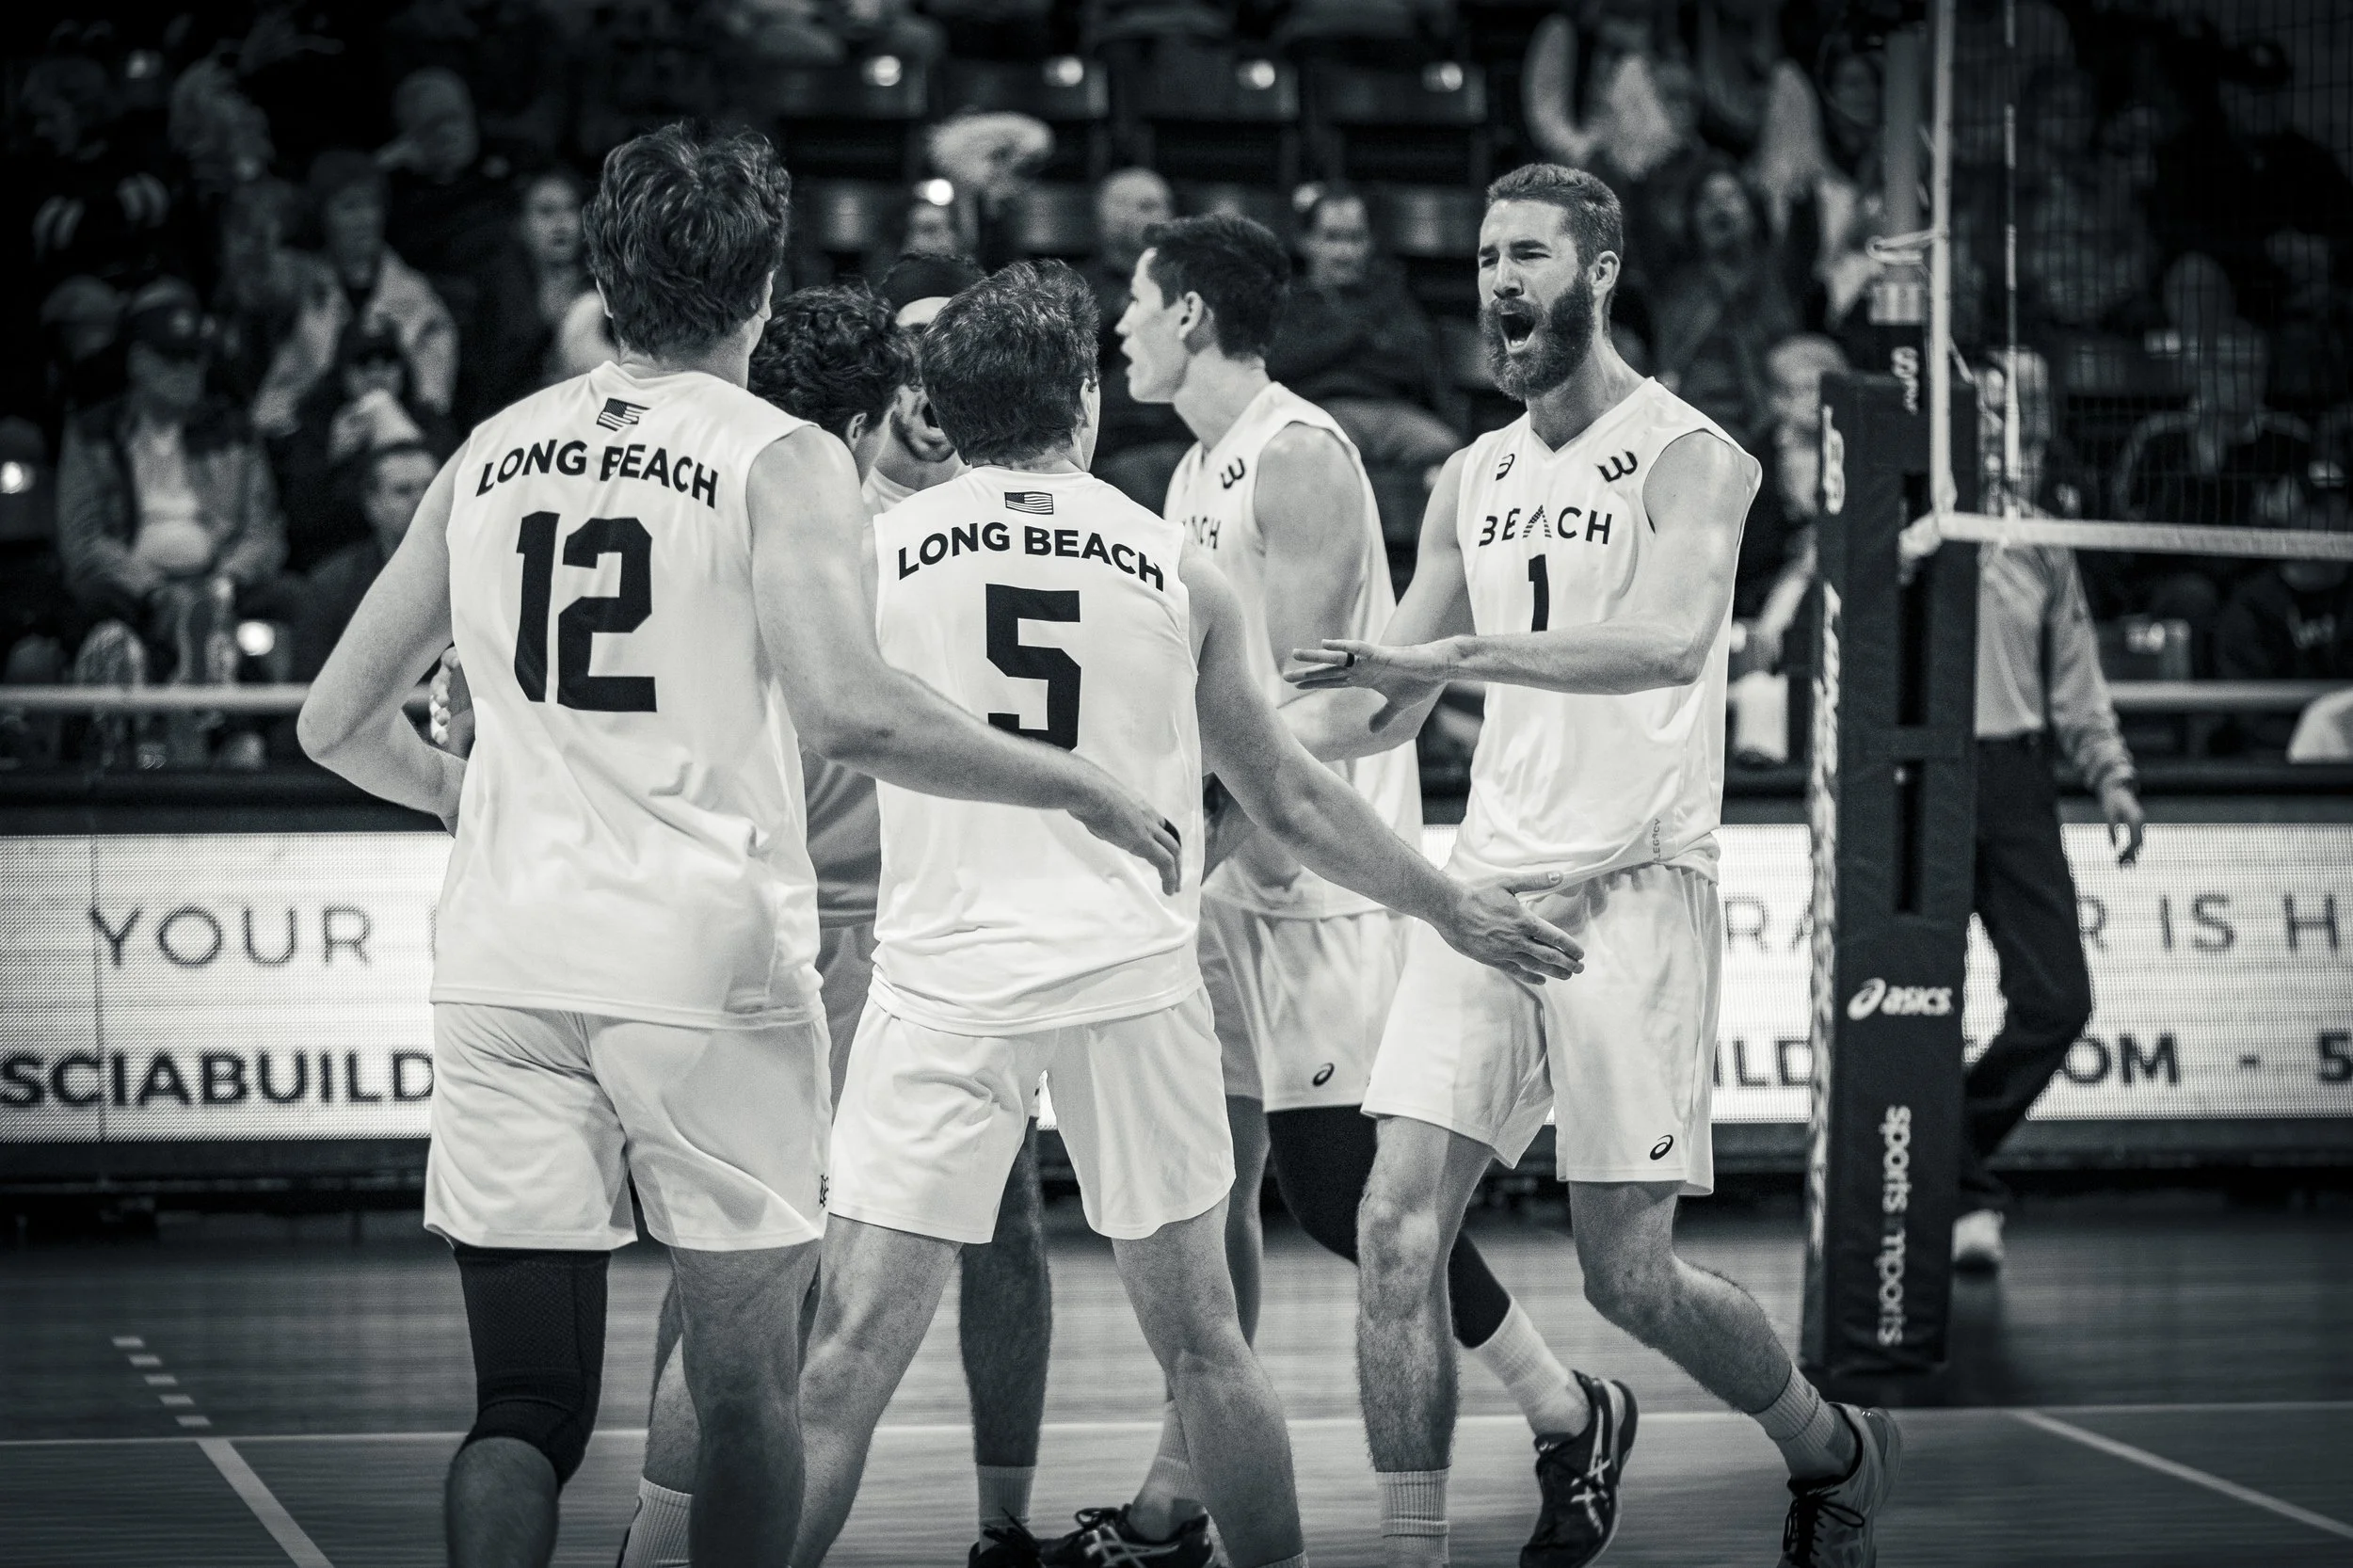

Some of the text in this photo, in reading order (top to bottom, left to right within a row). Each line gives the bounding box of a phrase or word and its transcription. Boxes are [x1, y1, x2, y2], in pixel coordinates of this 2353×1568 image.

[476, 440, 587, 497] LONG
[898, 521, 1164, 593] LONG BEACH
[1479, 504, 1612, 547] BEACH
[514, 510, 658, 713] 12
[1528, 553, 1550, 632] 1
[985, 583, 1081, 752] 5
[89, 905, 373, 967] YOUR
[2160, 894, 2237, 953] IS
[2283, 894, 2340, 953] H
[1881, 984, 1954, 1016] asics
[0, 1049, 435, 1108] SCIABUILD
[1880, 1105, 1912, 1213] sports
